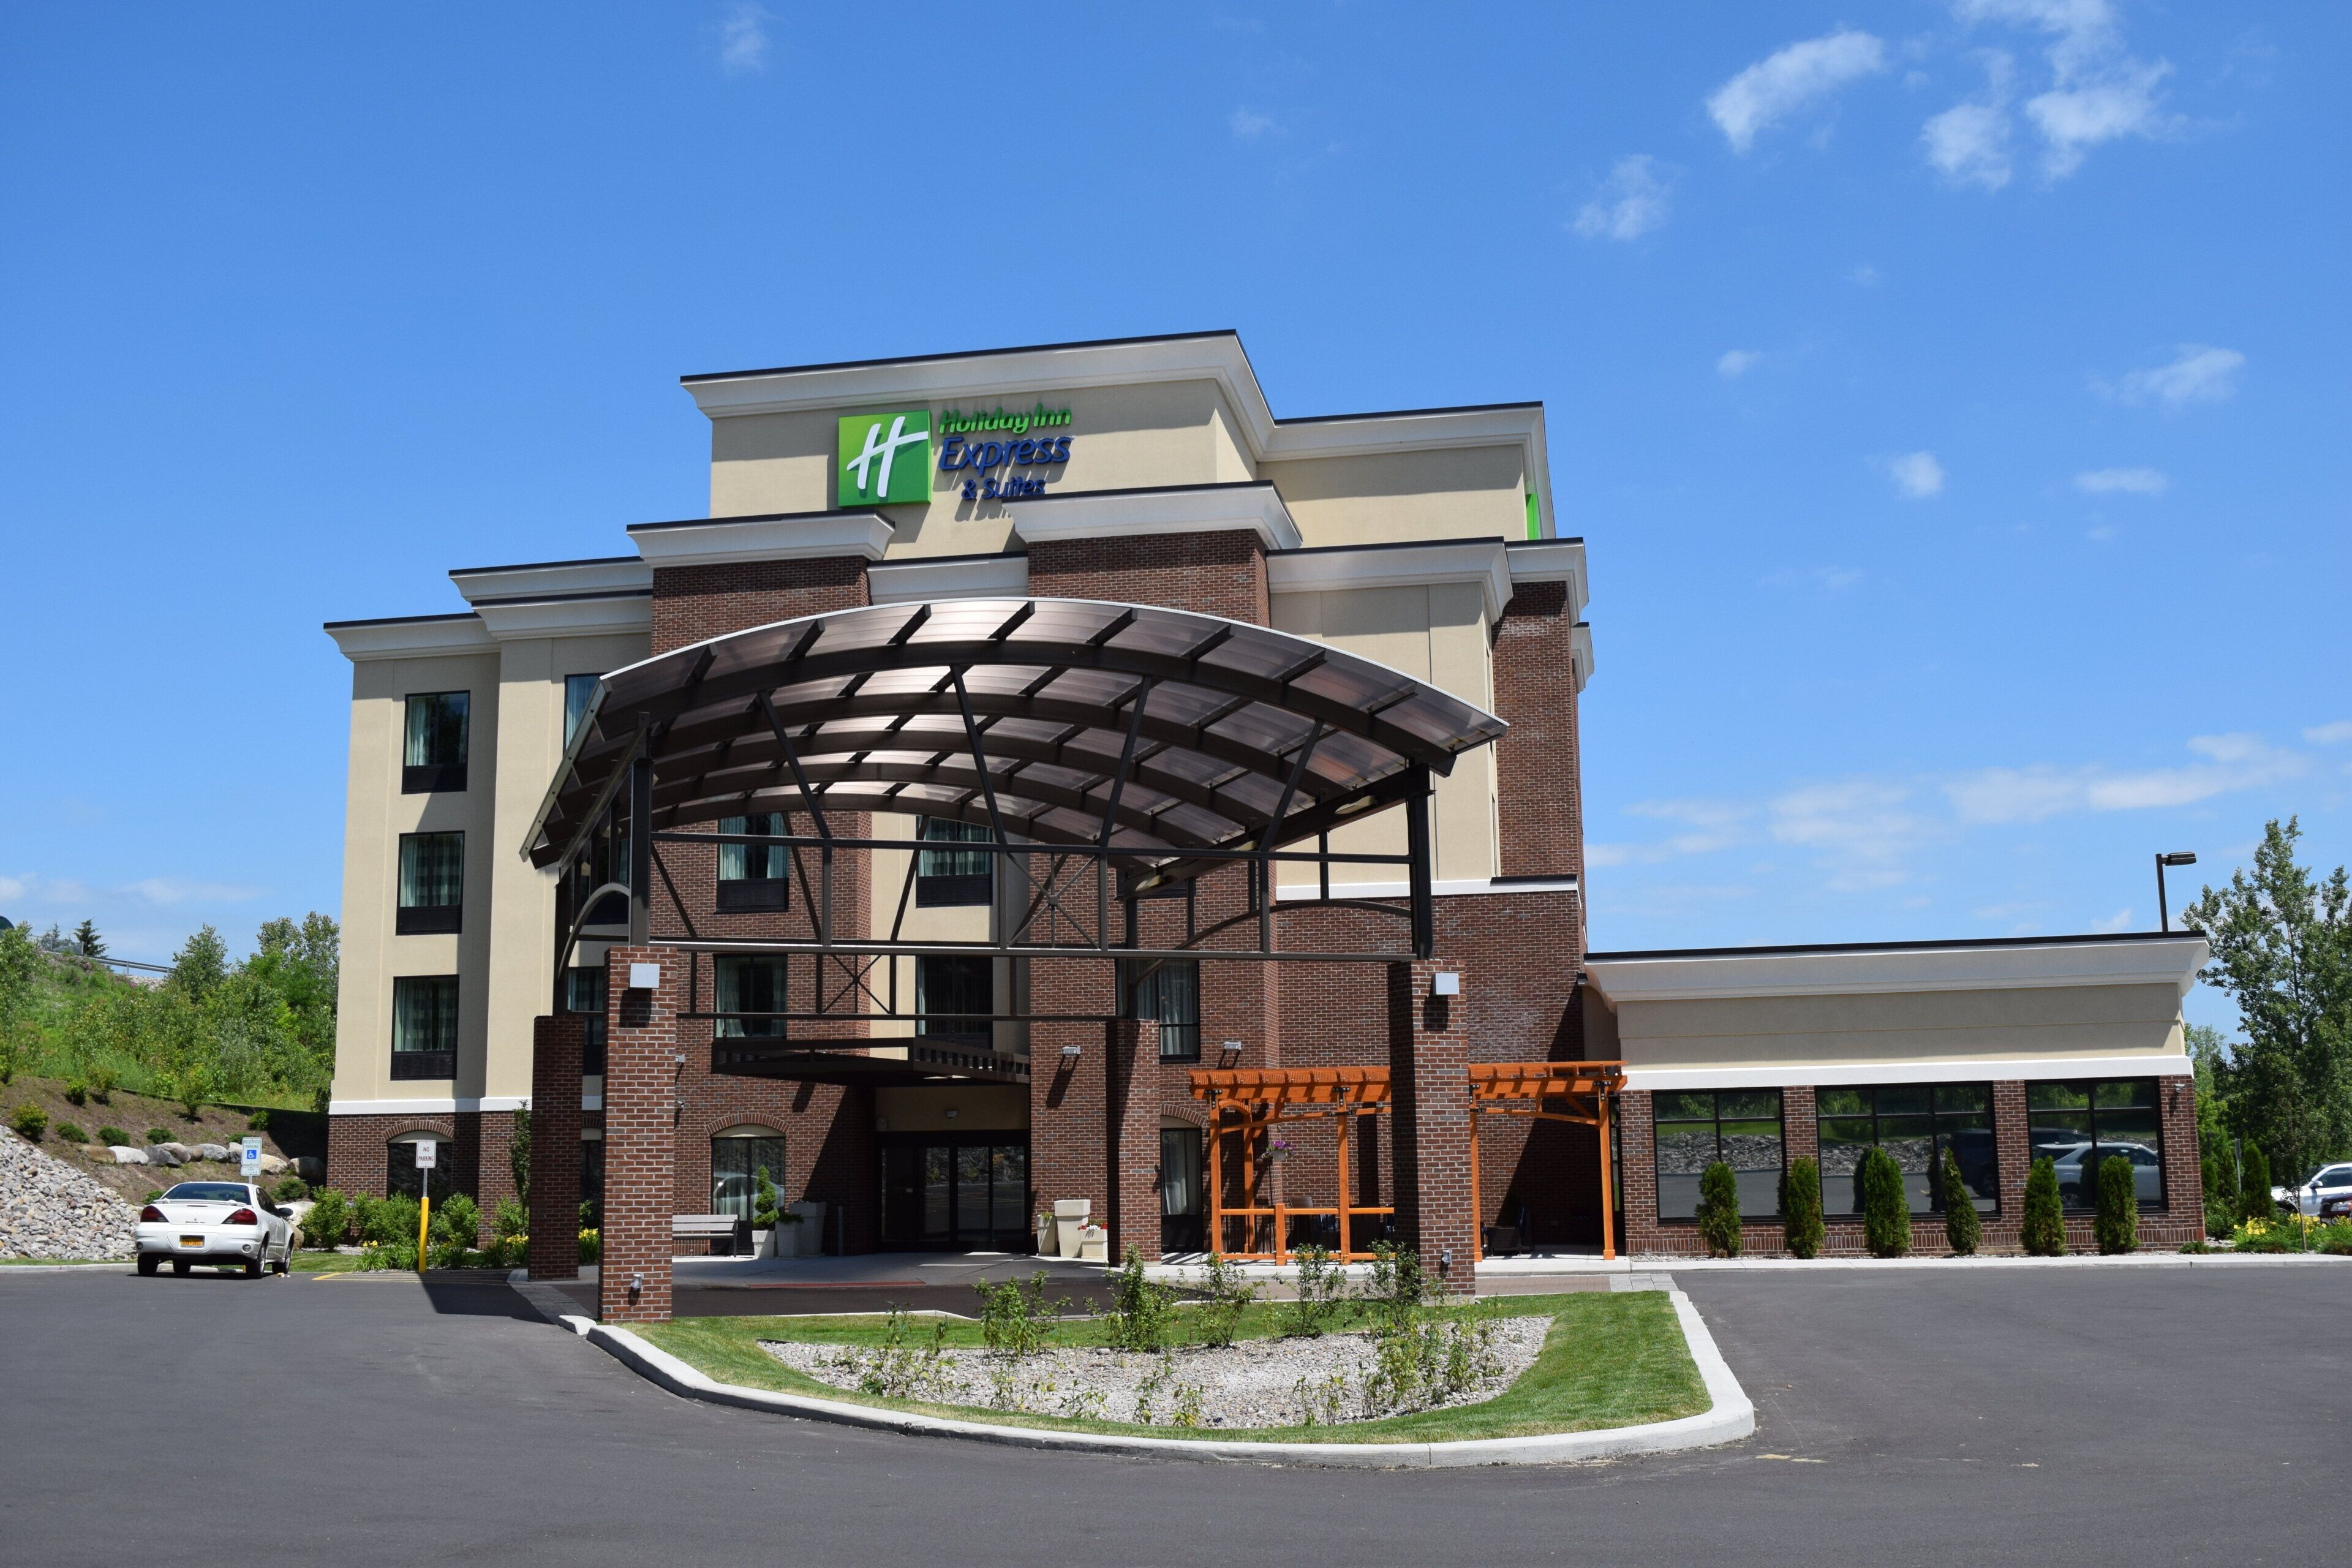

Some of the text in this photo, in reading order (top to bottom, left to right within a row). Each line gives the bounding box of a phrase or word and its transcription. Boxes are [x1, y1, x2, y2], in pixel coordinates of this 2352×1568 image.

[938, 402, 1072, 434] Holiday Inn
[938, 436, 1071, 477] Express
[961, 476, 1047, 501] & Suites
